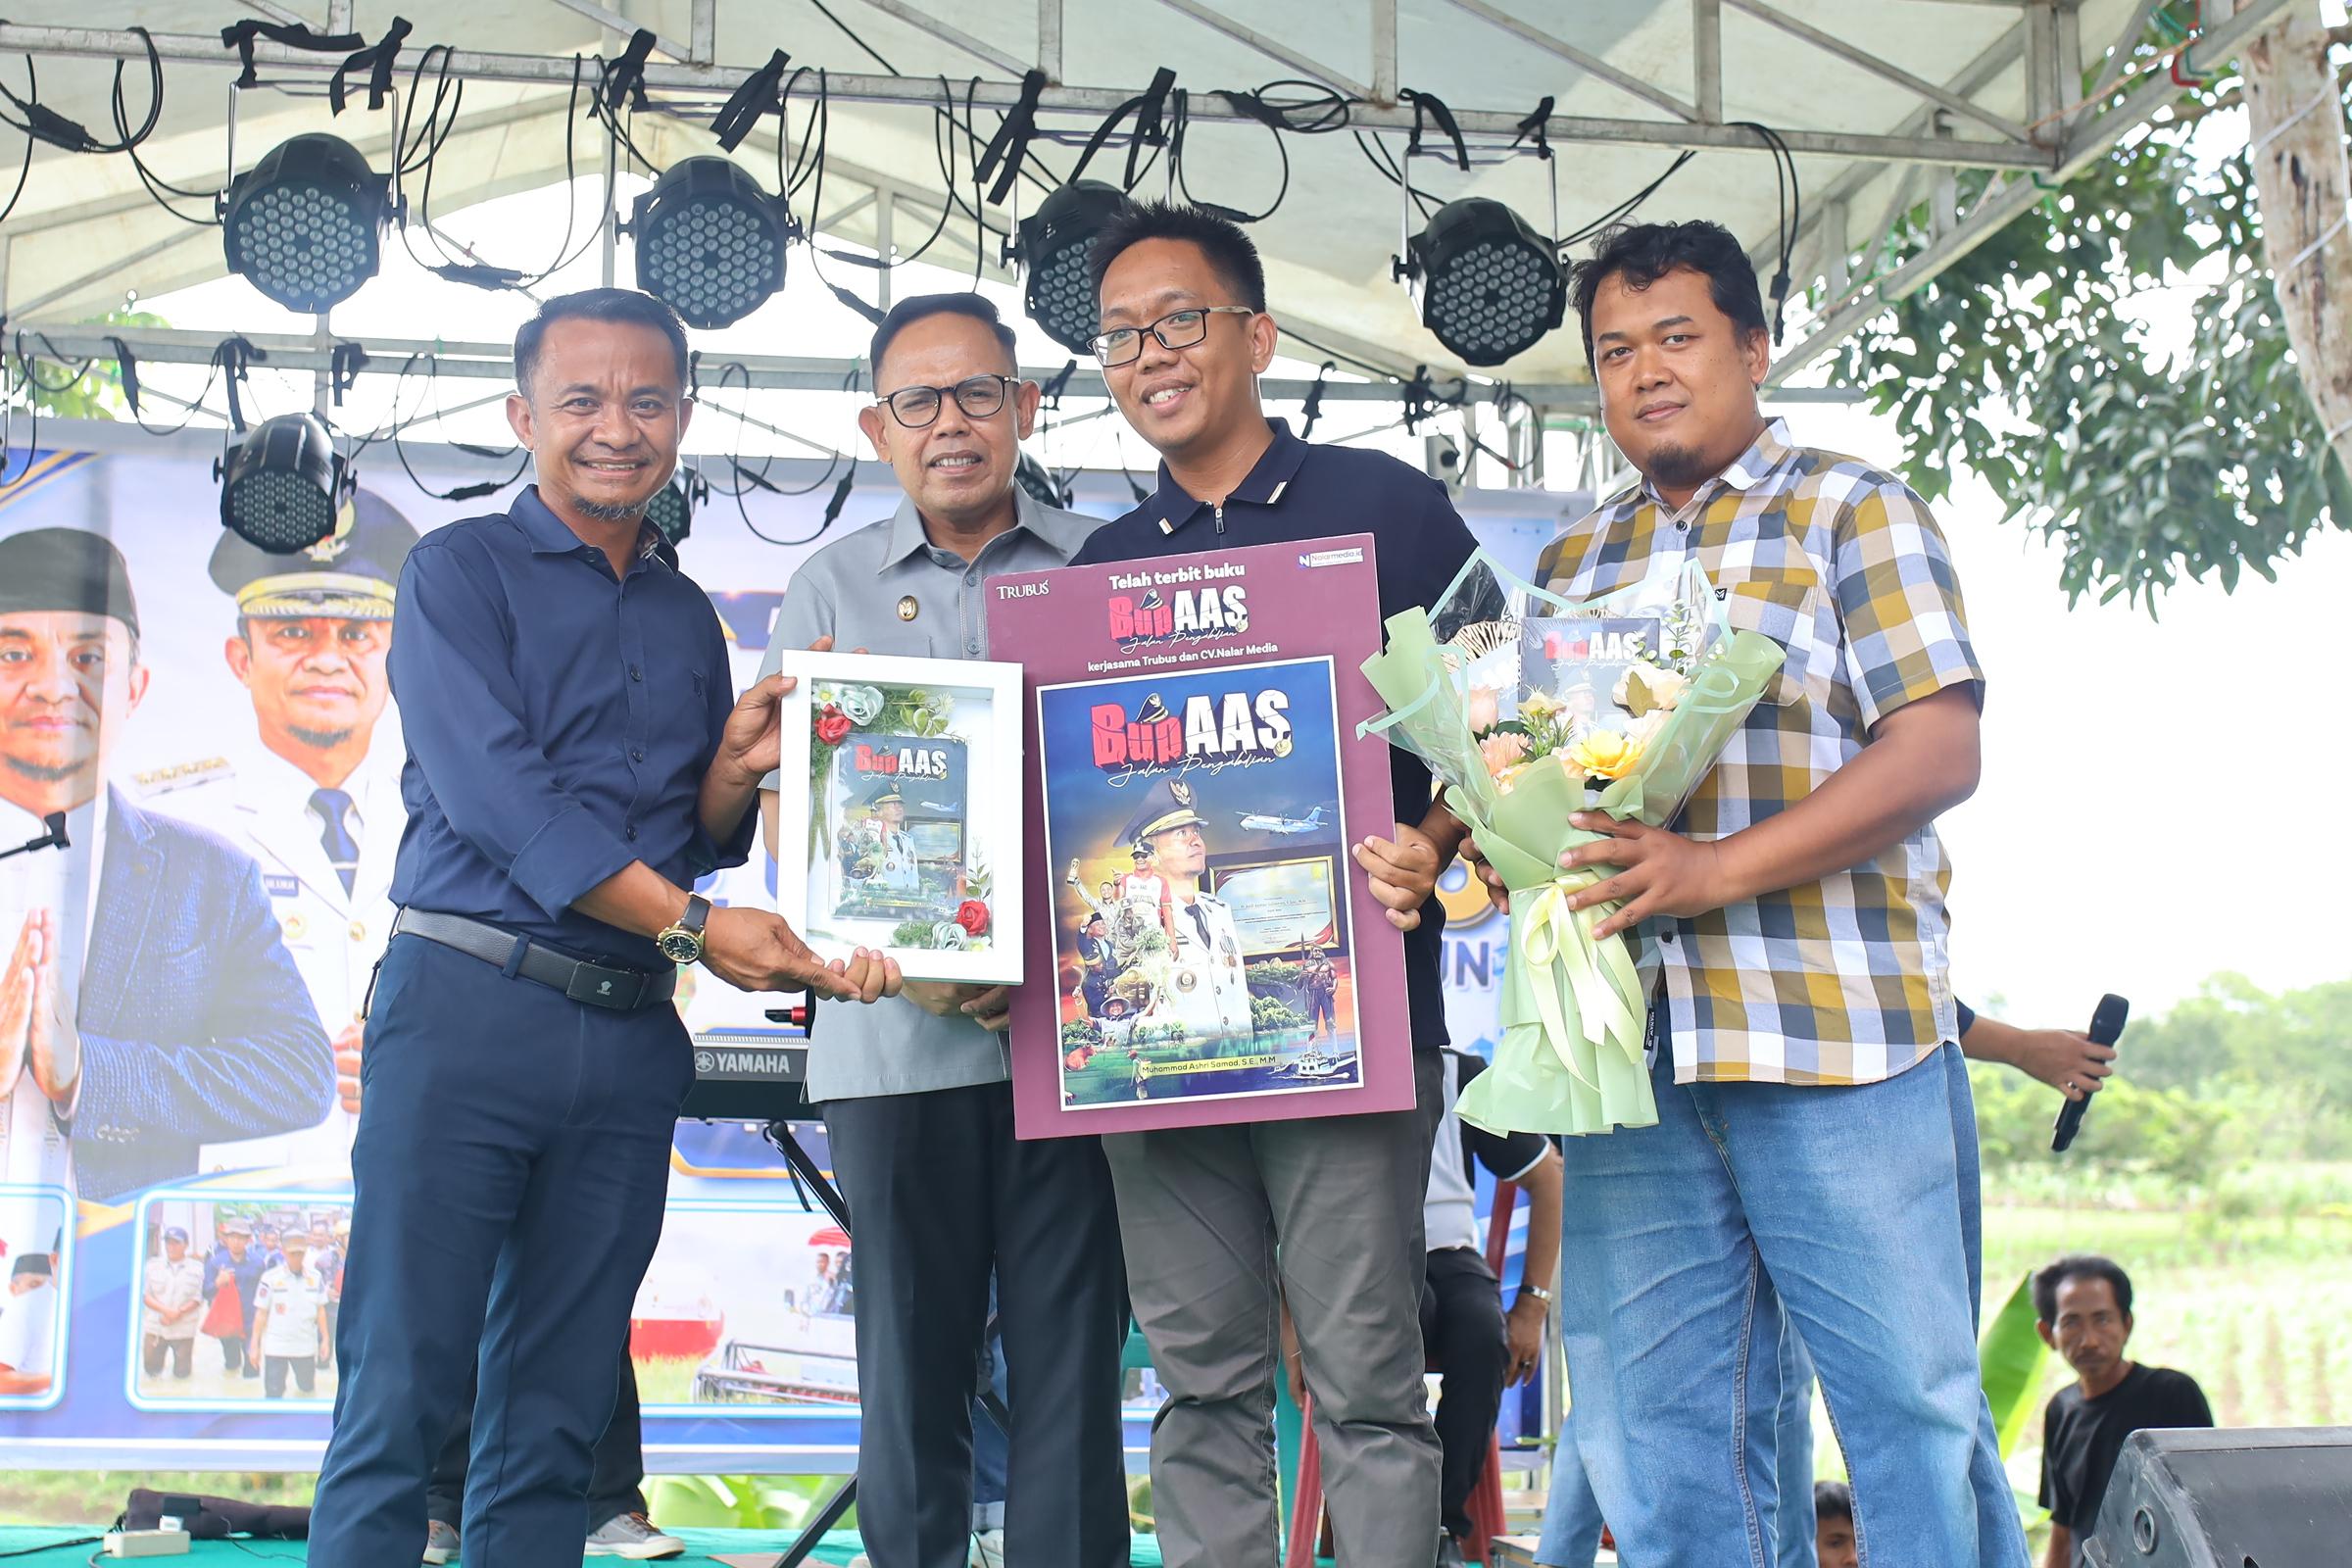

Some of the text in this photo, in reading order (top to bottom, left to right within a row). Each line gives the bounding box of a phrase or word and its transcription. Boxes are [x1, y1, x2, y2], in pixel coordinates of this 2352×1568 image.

[996, 579, 1050, 600] TRUBUS
[1108, 562, 1246, 590] Telah terbit buku
[1108, 585, 1249, 641] BupAAS
[1087, 642, 1279, 673] kerjasama Trubus dan CV.Nalar Media
[1120, 635, 1164, 655] Jalan
[1091, 689, 1292, 768] BupAAS
[1107, 751, 1276, 788] Jalan Pengabdian
[715, 1053, 791, 1074] YAMAHA
[1142, 1064, 1188, 1075] Muhammad
[1189, 1061, 1209, 1070] Ashri
